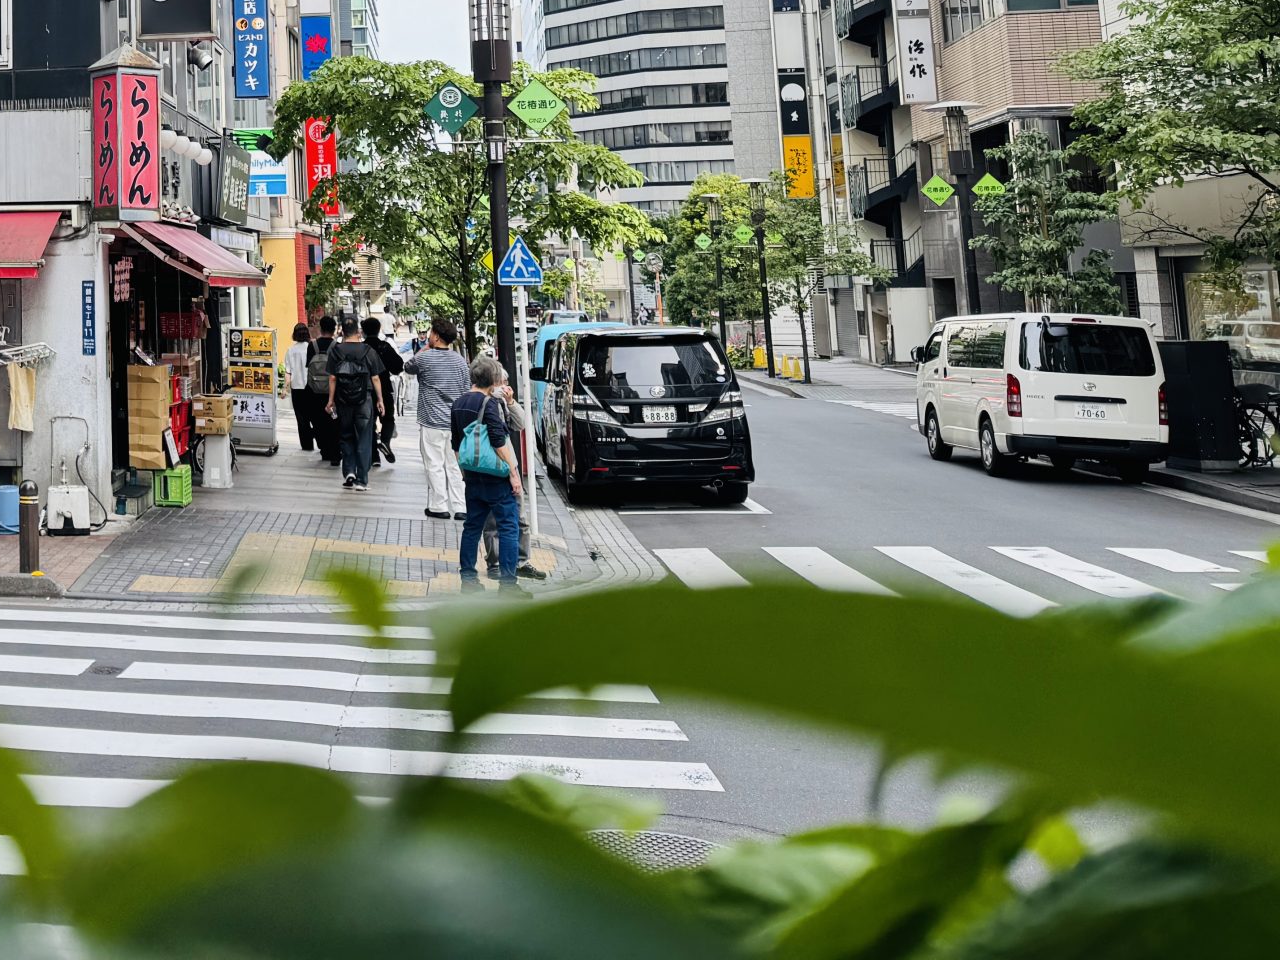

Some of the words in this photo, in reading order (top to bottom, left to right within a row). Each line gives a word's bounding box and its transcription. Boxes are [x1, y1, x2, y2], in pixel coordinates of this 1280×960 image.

[244, 42, 260, 91] カツキ
[517, 99, 557, 110] 花椿通り
[99, 80, 114, 204] らーめん
[128, 78, 152, 205] らーめん
[250, 159, 284, 169] ilyMat
[650, 412, 675, 421] 88-88
[1081, 409, 1106, 419] 70-60
